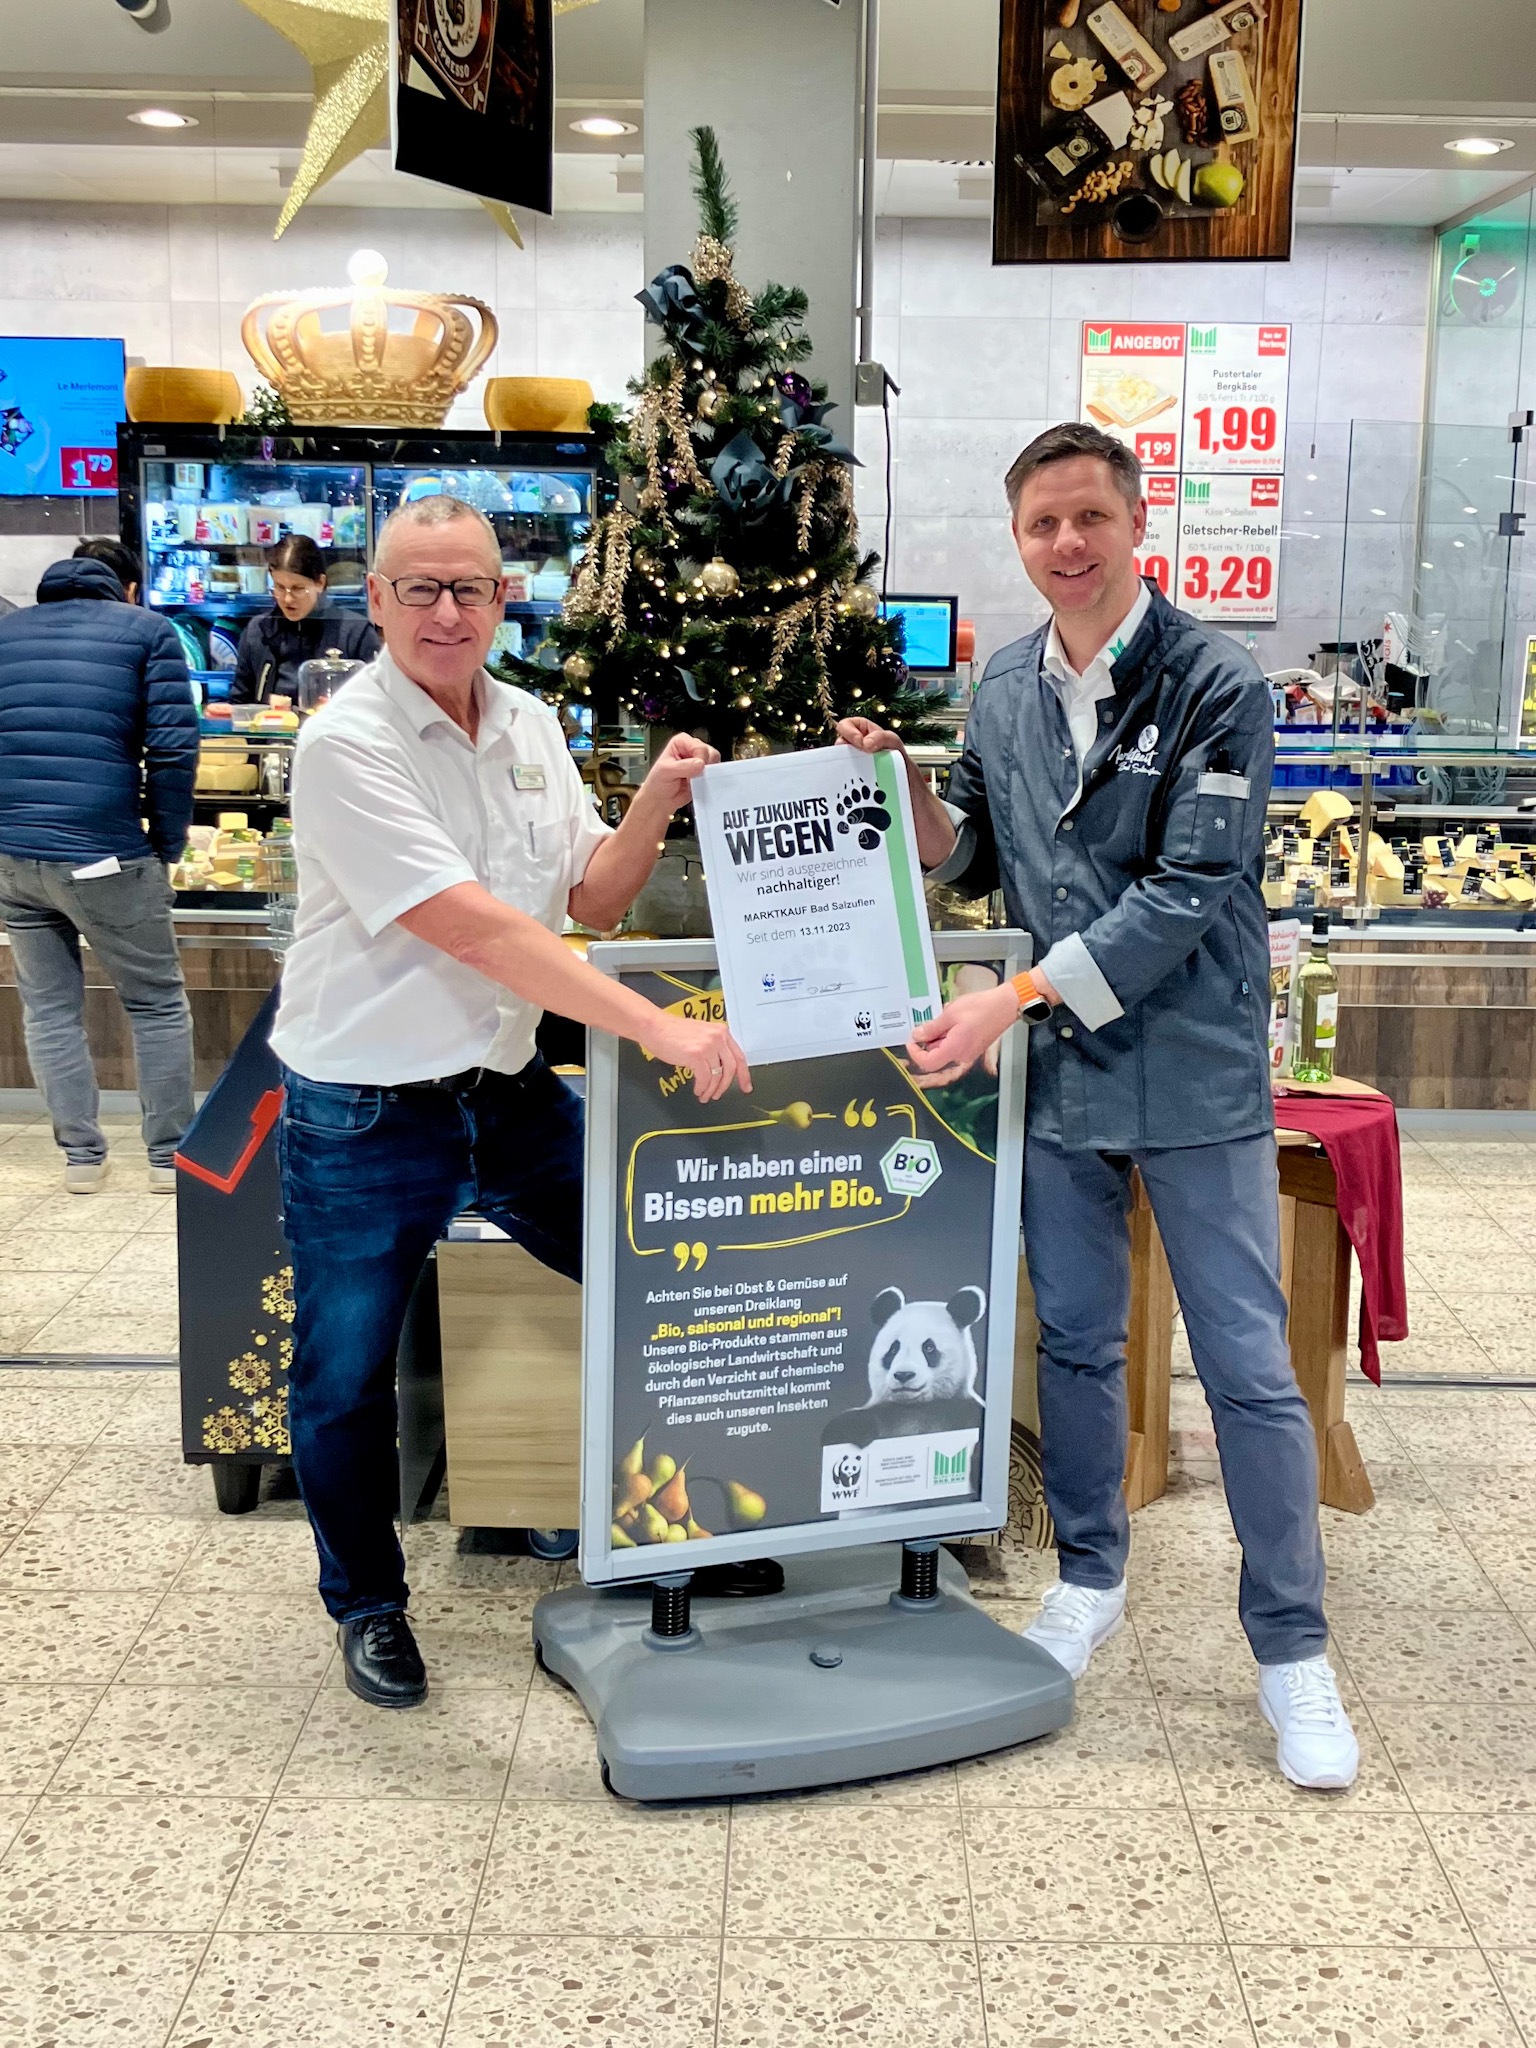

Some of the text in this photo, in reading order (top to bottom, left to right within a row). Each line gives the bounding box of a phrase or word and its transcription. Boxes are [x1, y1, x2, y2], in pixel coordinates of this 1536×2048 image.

[1113, 335, 1181, 350] ANGEBOT
[57, 382, 69, 391] Le
[1213, 369, 1262, 378] Pustertaler
[1217, 382, 1257, 392] Bergkäse
[1193, 406, 1276, 455] 1,99
[1184, 556, 1271, 603] 3,29
[723, 797, 829, 831] AUF ZUKUNFTS
[725, 818, 835, 866] WEGEN
[737, 857, 868, 884] Wir sind ausgezeichnet
[757, 874, 841, 896] nachhaltiger!
[744, 898, 876, 922] MARKTKAUF Bad Salzuflen
[746, 921, 851, 945] Seit dem 13.11.2023
[676, 1150, 862, 1183] Wir haben einen
[644, 1178, 882, 1223] Bissen mehr Bio.
[646, 1273, 849, 1304] Achten Sie bei Obst & Gemüse auf
[694, 1297, 801, 1317] unseren Dreiklang
[687, 1316, 745, 1336] saisonal
[748, 1313, 774, 1329] und
[643, 1327, 848, 1357] Unsere Bio-Produkte stammen aus
[648, 1342, 843, 1375] ökologischer Landwirtschaft und
[645, 1361, 845, 1392] durch den Verzicht auf chemische
[659, 1379, 831, 1409] Pflanzenschutzmittel kommt
[666, 1397, 828, 1426] dies auch unseren Insekten
[726, 1422, 772, 1438] zugute.
[832, 1488, 860, 1500] WWF
